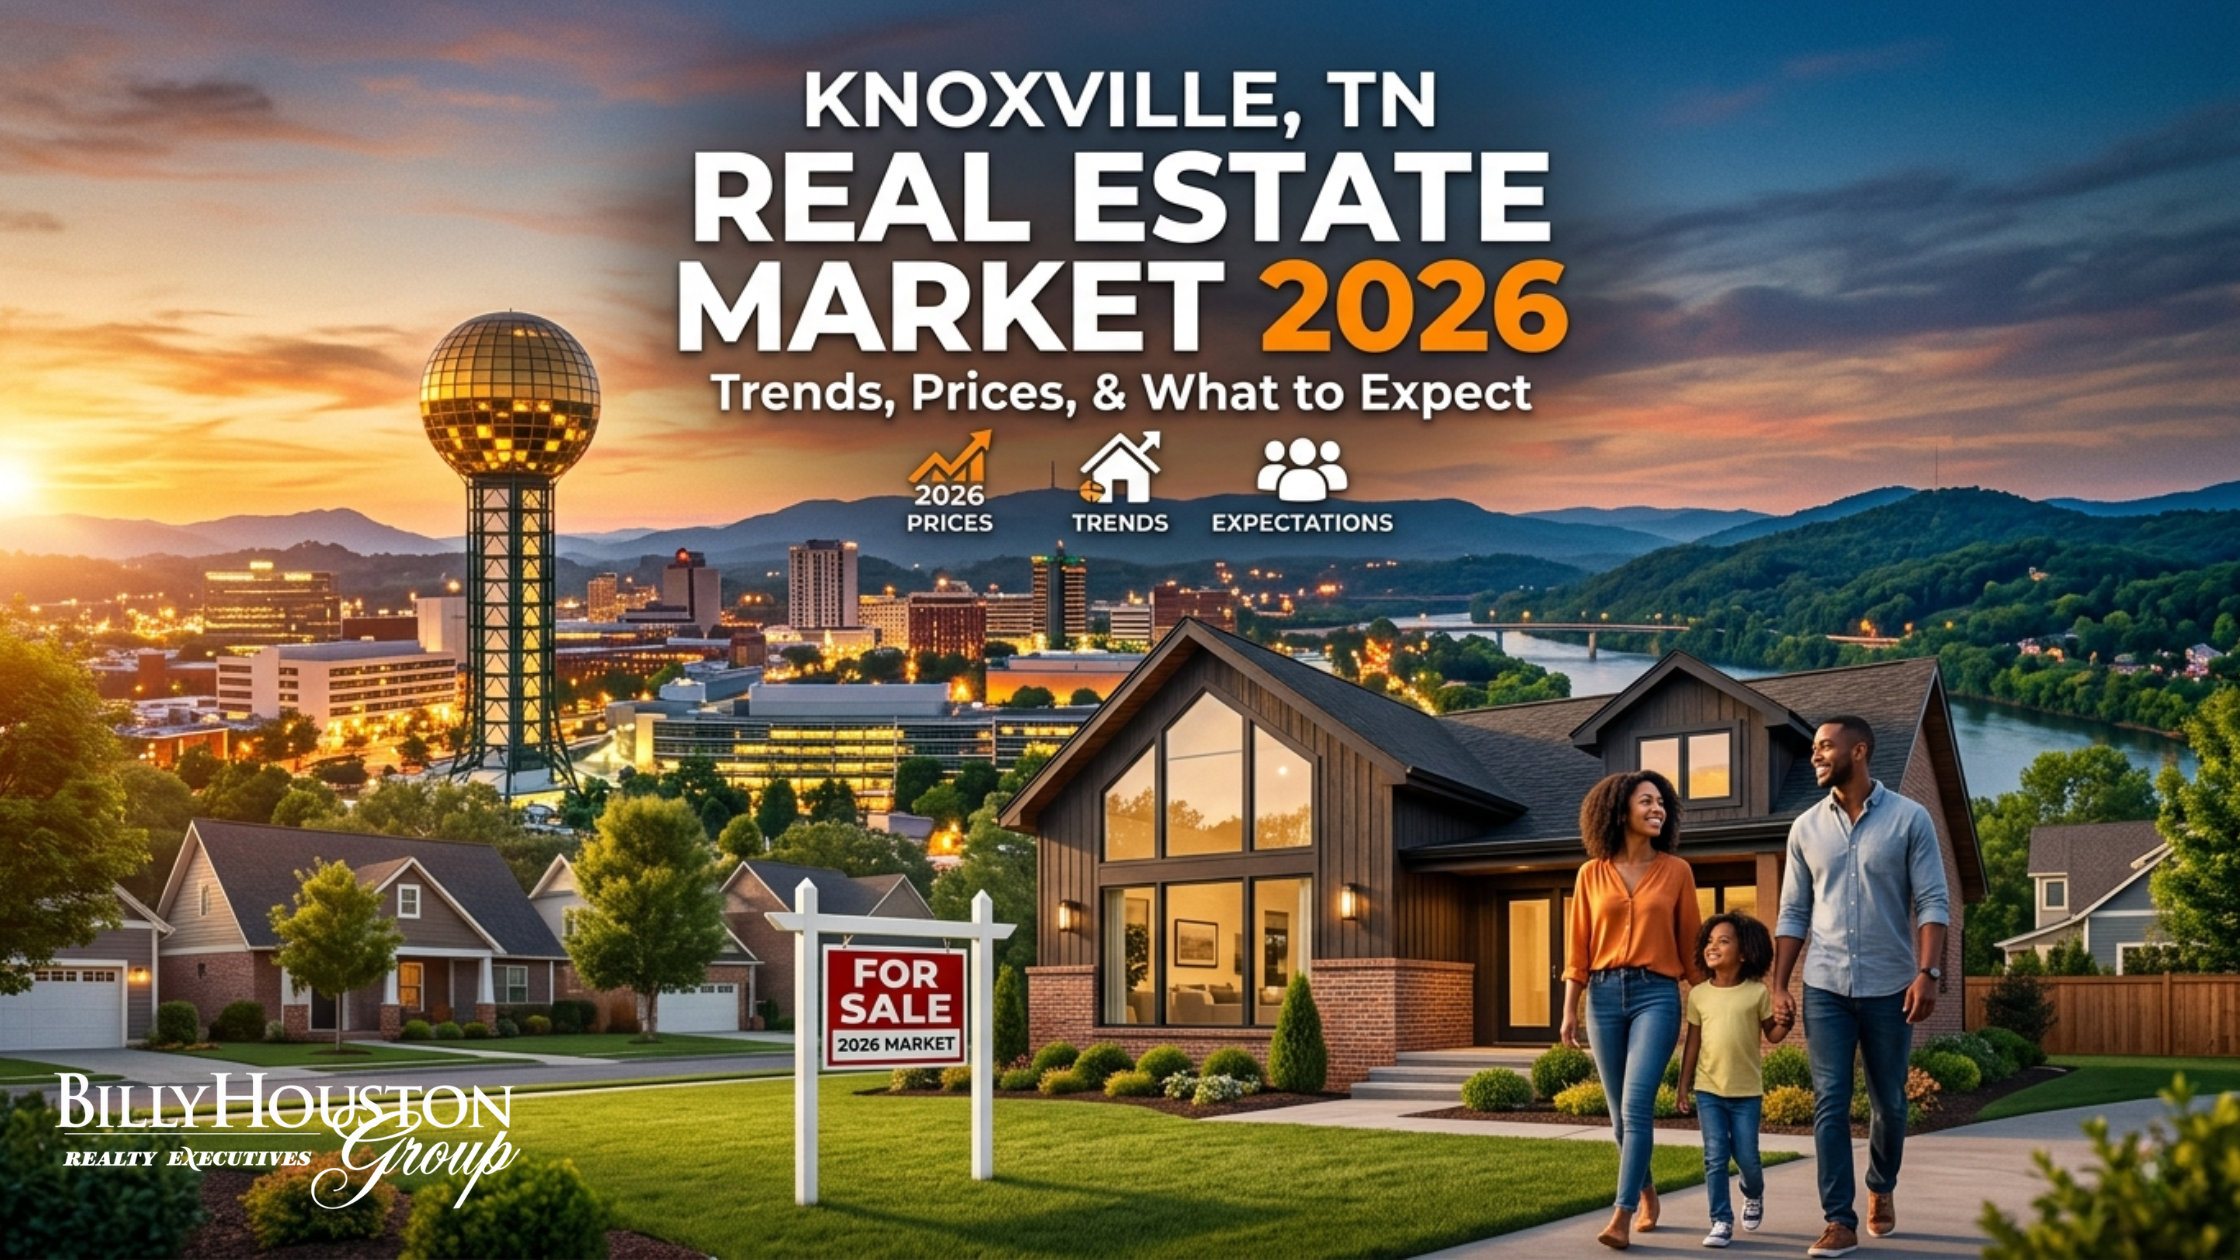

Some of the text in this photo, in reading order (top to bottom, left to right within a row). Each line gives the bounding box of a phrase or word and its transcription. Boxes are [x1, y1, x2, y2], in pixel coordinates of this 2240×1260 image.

[854, 957, 939, 989] FOR
[840, 992, 953, 1024] SALE
[837, 1036, 956, 1052] 2026 MARKET
